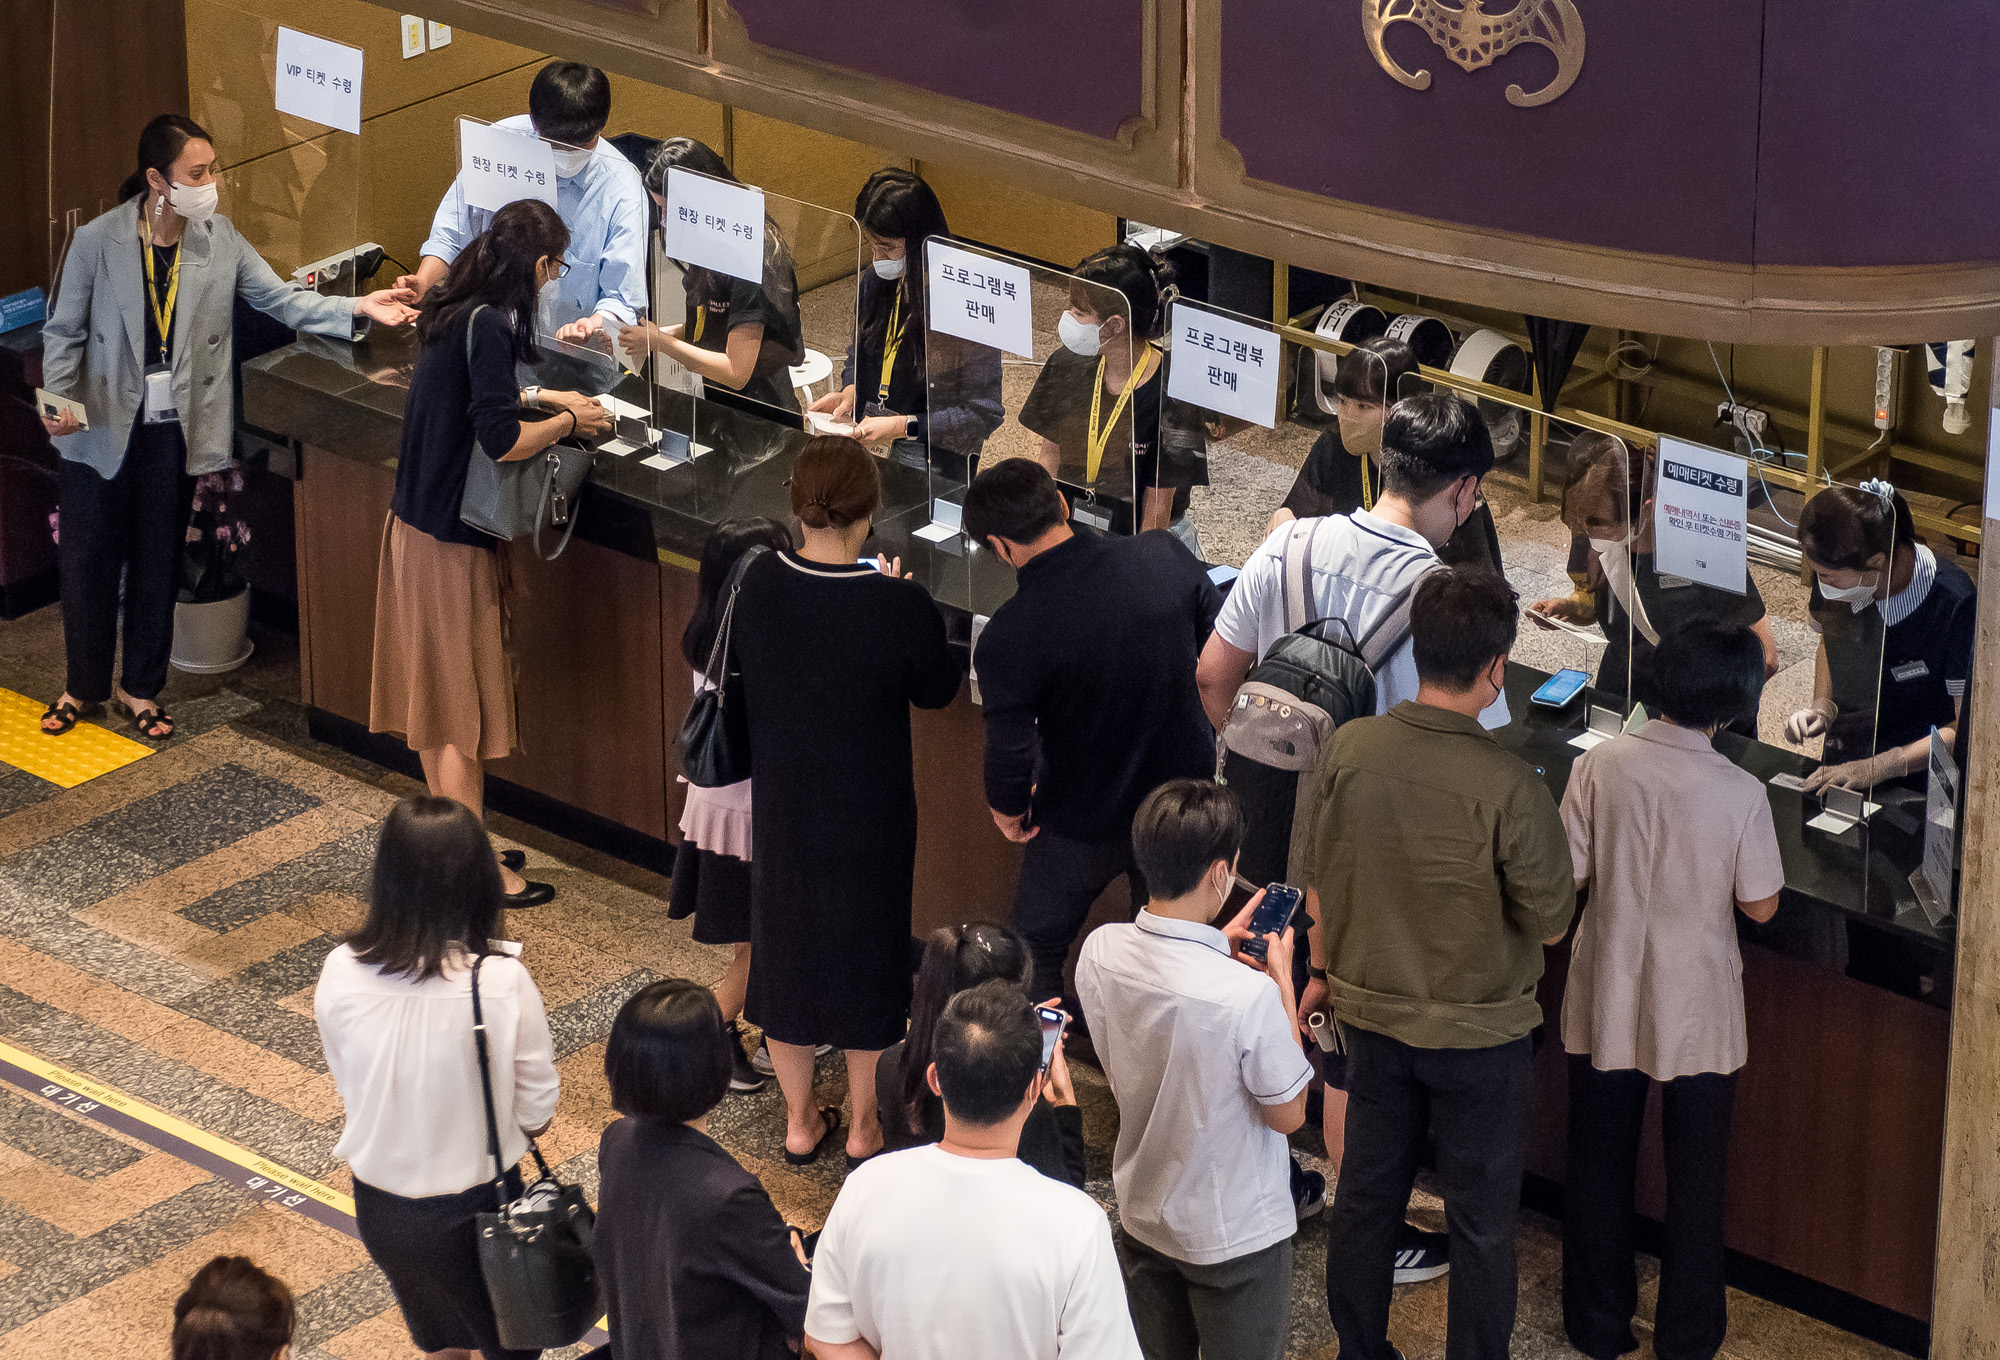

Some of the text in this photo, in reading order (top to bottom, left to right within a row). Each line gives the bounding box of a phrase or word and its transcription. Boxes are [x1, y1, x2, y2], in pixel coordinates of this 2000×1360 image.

[286, 63, 352, 94] VIP 티켓 수령
[472, 155, 546, 186] 현장 티켓 수령
[678, 206, 753, 240] 현장 티켓 수령
[941, 263, 1017, 302] 프로그램북
[965, 299, 995, 325] 판매
[1185, 326, 1264, 368] 프로그램북
[1207, 365, 1238, 393] 판매
[1667, 463, 1738, 494] 예매티켓 수령
[1668, 516, 1684, 529] 확인
[1685, 521, 1693, 530] 후
[1702, 513, 1718, 525] 또는
[40, 1083, 100, 1114] 대기선
[47, 1069, 128, 1108] Please wait here
[245, 1176, 307, 1208] 대기선
[252, 1160, 336, 1201] Please wait here
